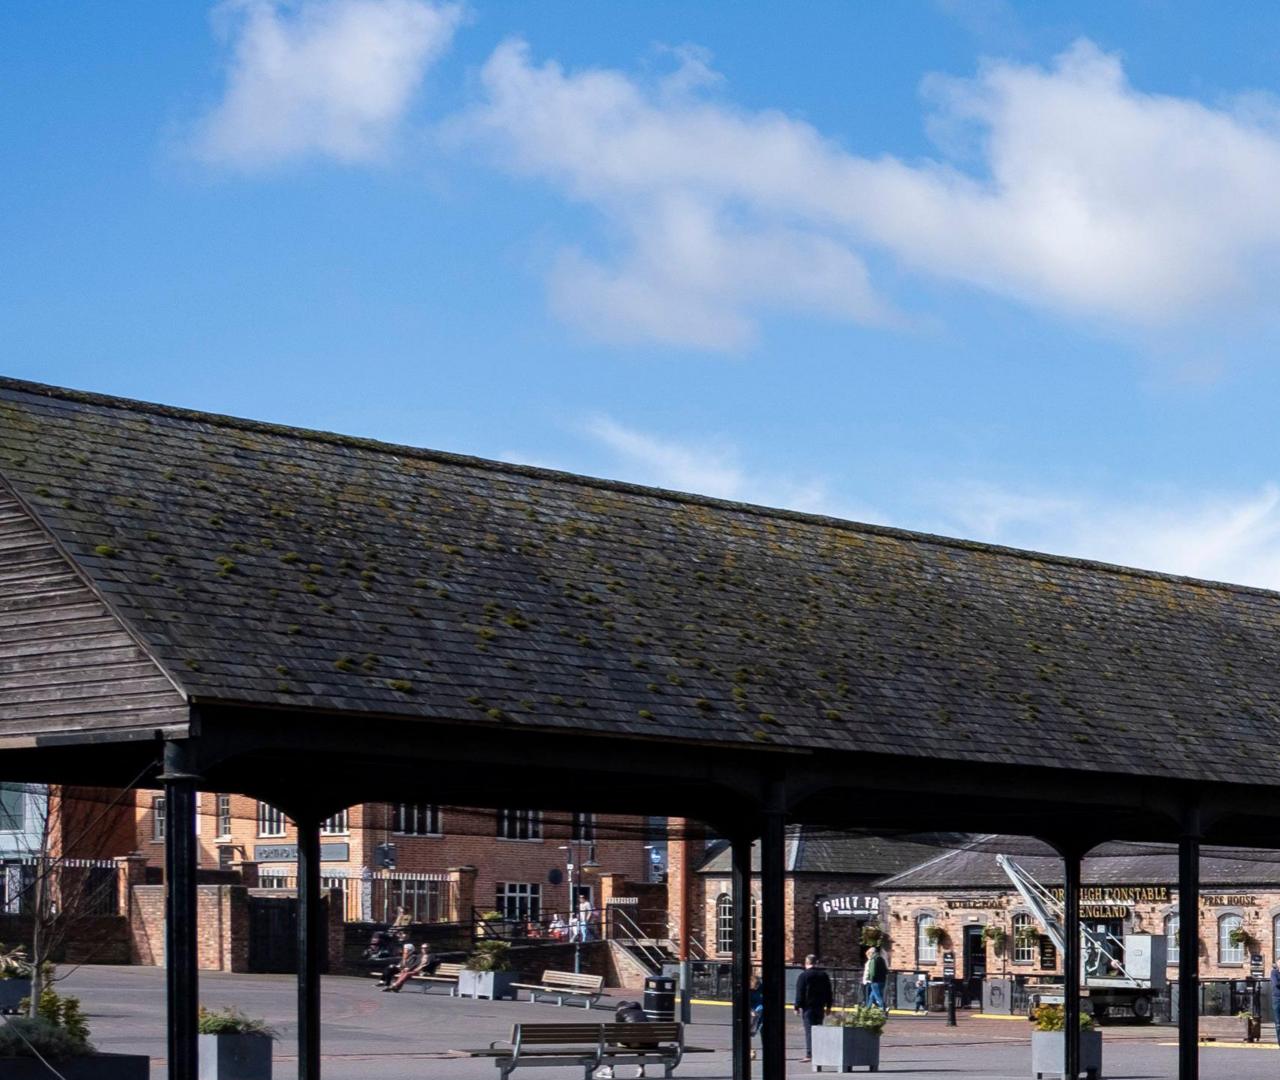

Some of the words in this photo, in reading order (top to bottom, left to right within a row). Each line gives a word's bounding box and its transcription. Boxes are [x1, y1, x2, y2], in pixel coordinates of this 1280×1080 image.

[1106, 887, 1167, 900] CONSTABLE
[822, 896, 859, 913] GUILT
[1227, 895, 1256, 907] HOUSE
[1079, 905, 1127, 918] ENGLAND
